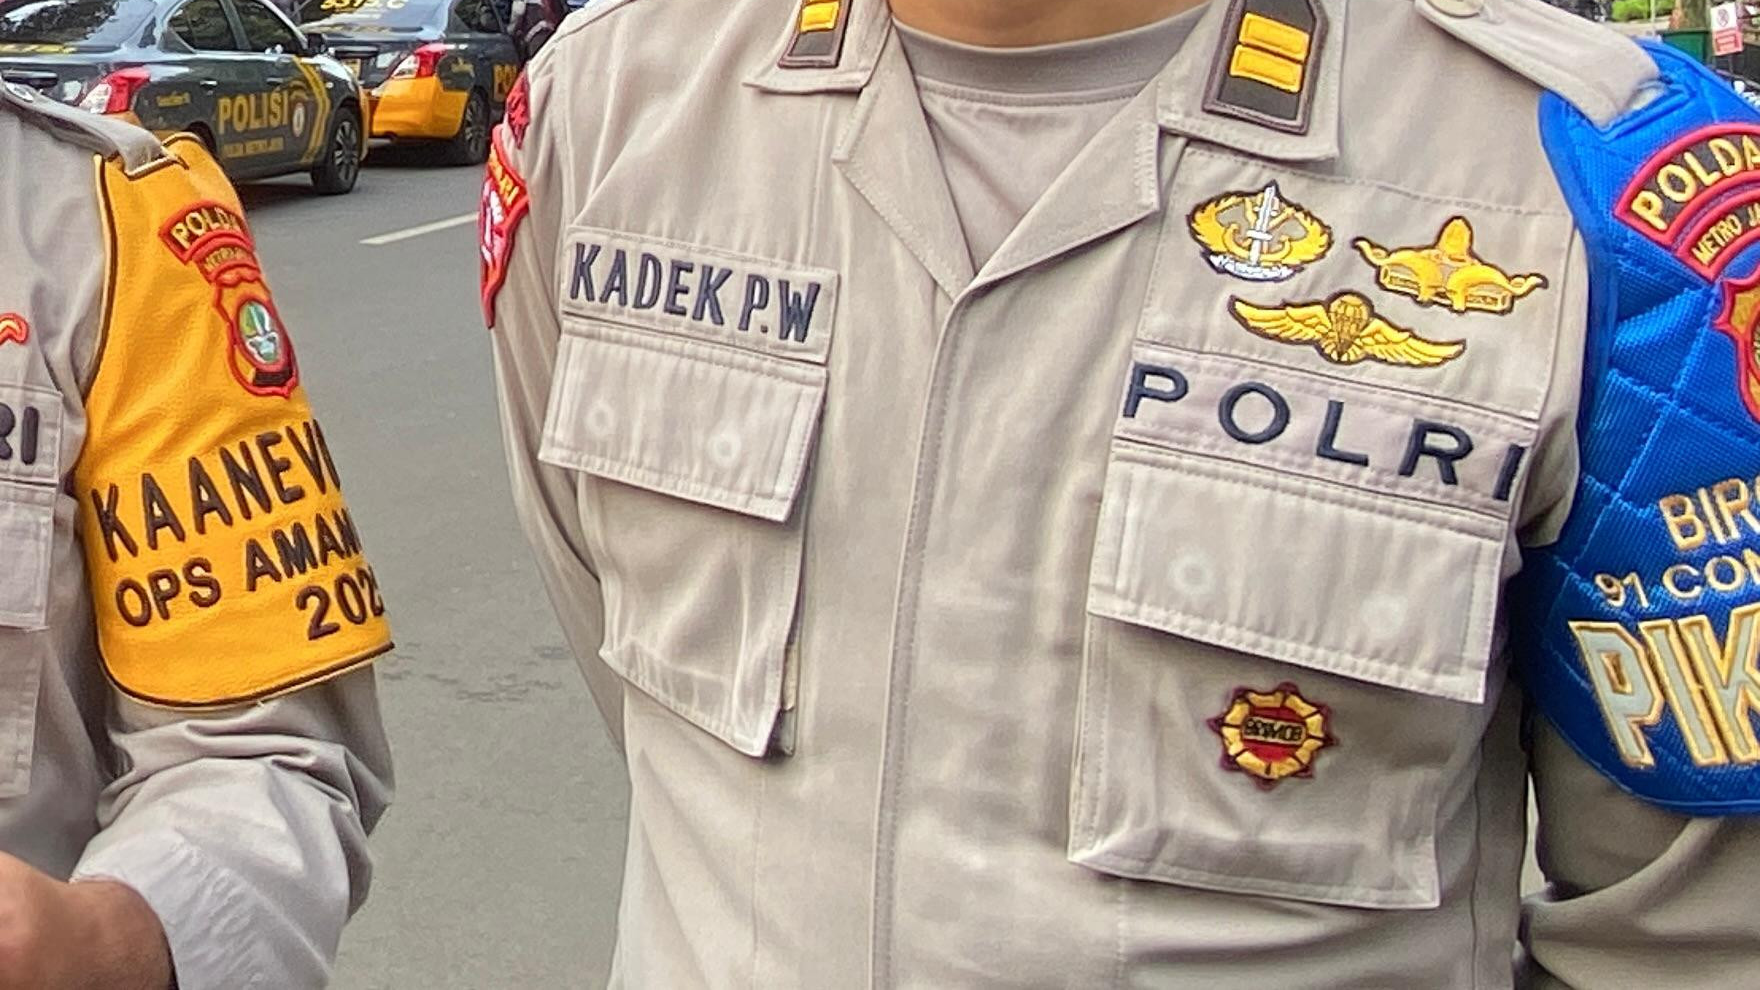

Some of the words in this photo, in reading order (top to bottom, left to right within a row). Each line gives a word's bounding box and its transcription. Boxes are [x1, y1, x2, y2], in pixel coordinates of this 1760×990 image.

[217, 89, 290, 135] POLISI
[569, 241, 733, 327] KADEK
[738, 272, 821, 343] P.W
[1122, 361, 1526, 502] POLRI
[1659, 476, 1760, 551] BIR
[115, 556, 222, 627] OPS
[1595, 571, 1649, 609] 91
